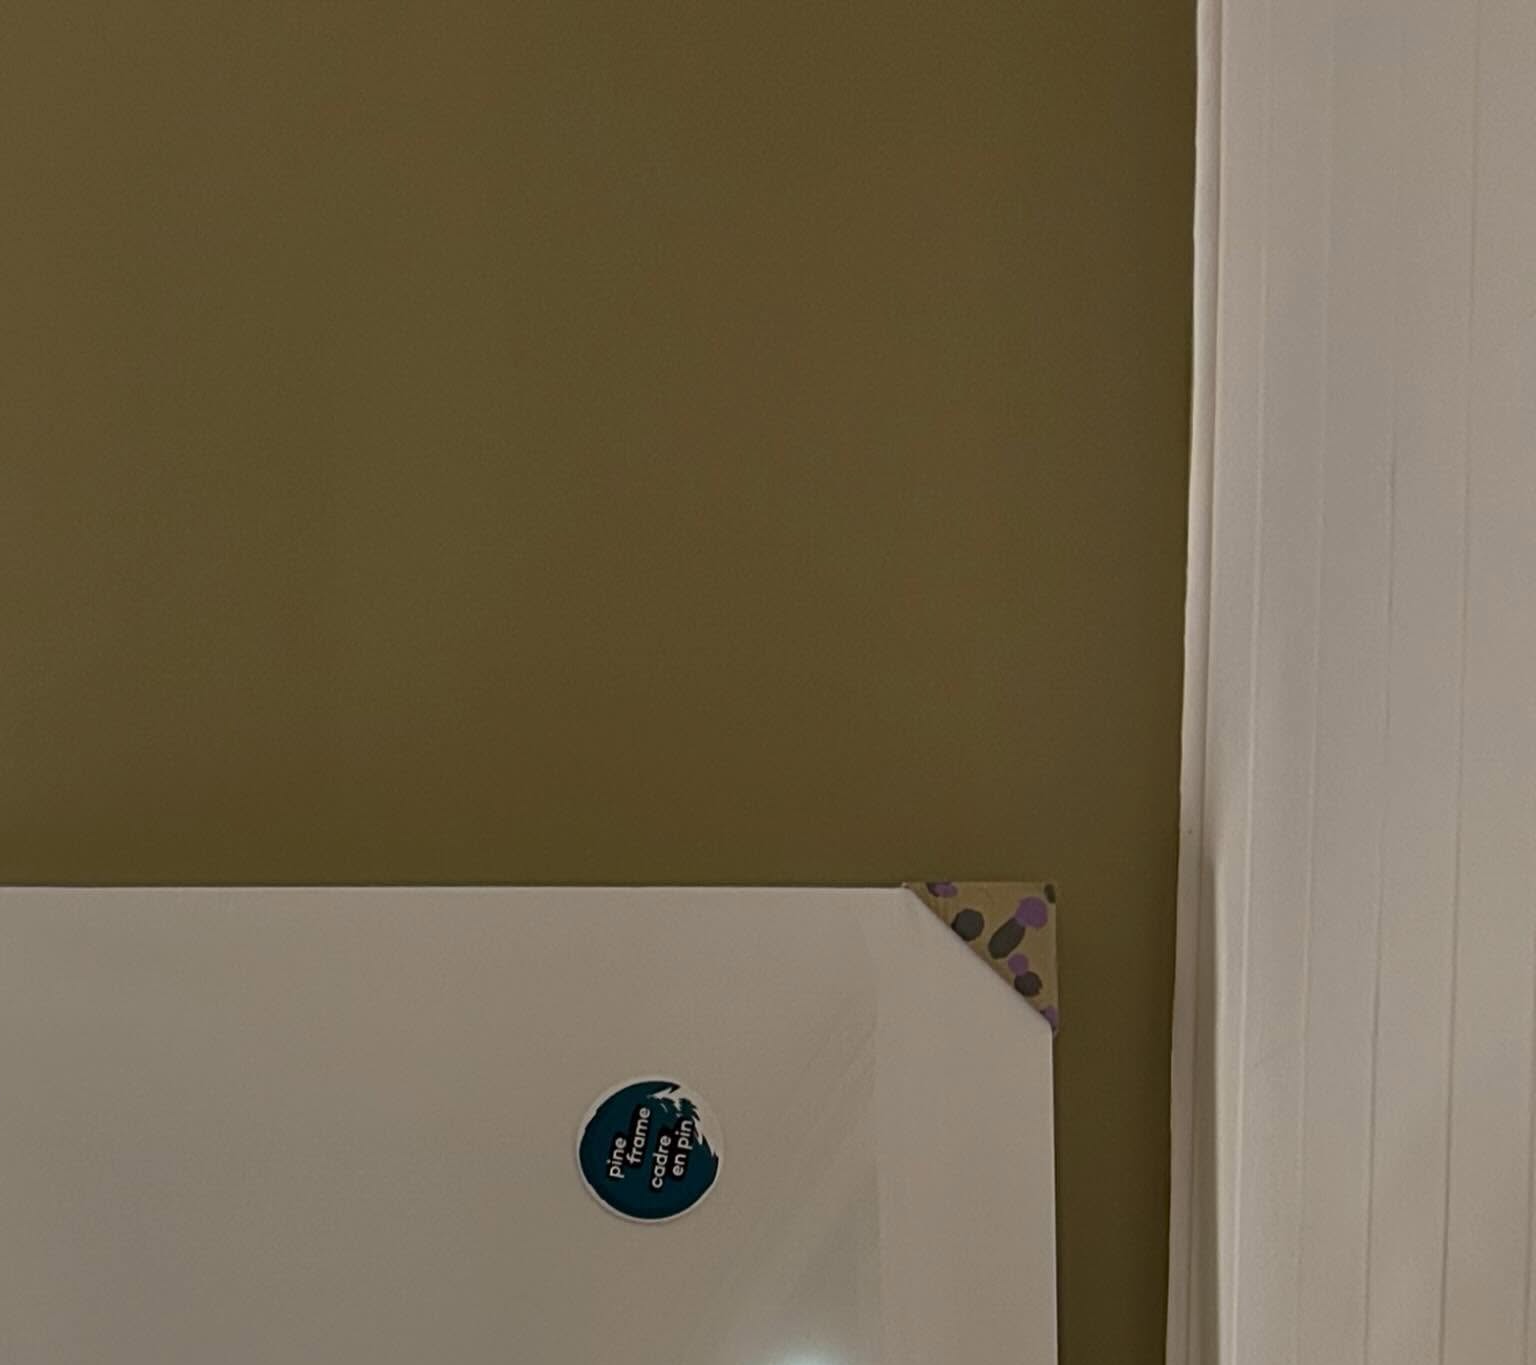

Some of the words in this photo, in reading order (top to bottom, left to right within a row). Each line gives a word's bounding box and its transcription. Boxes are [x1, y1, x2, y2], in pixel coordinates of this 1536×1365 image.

[626, 1108, 650, 1164] frame
[675, 1120, 693, 1150] pin
[607, 1137, 626, 1178] pine
[651, 1136, 671, 1188] cadre
[671, 1154, 686, 1176] en
